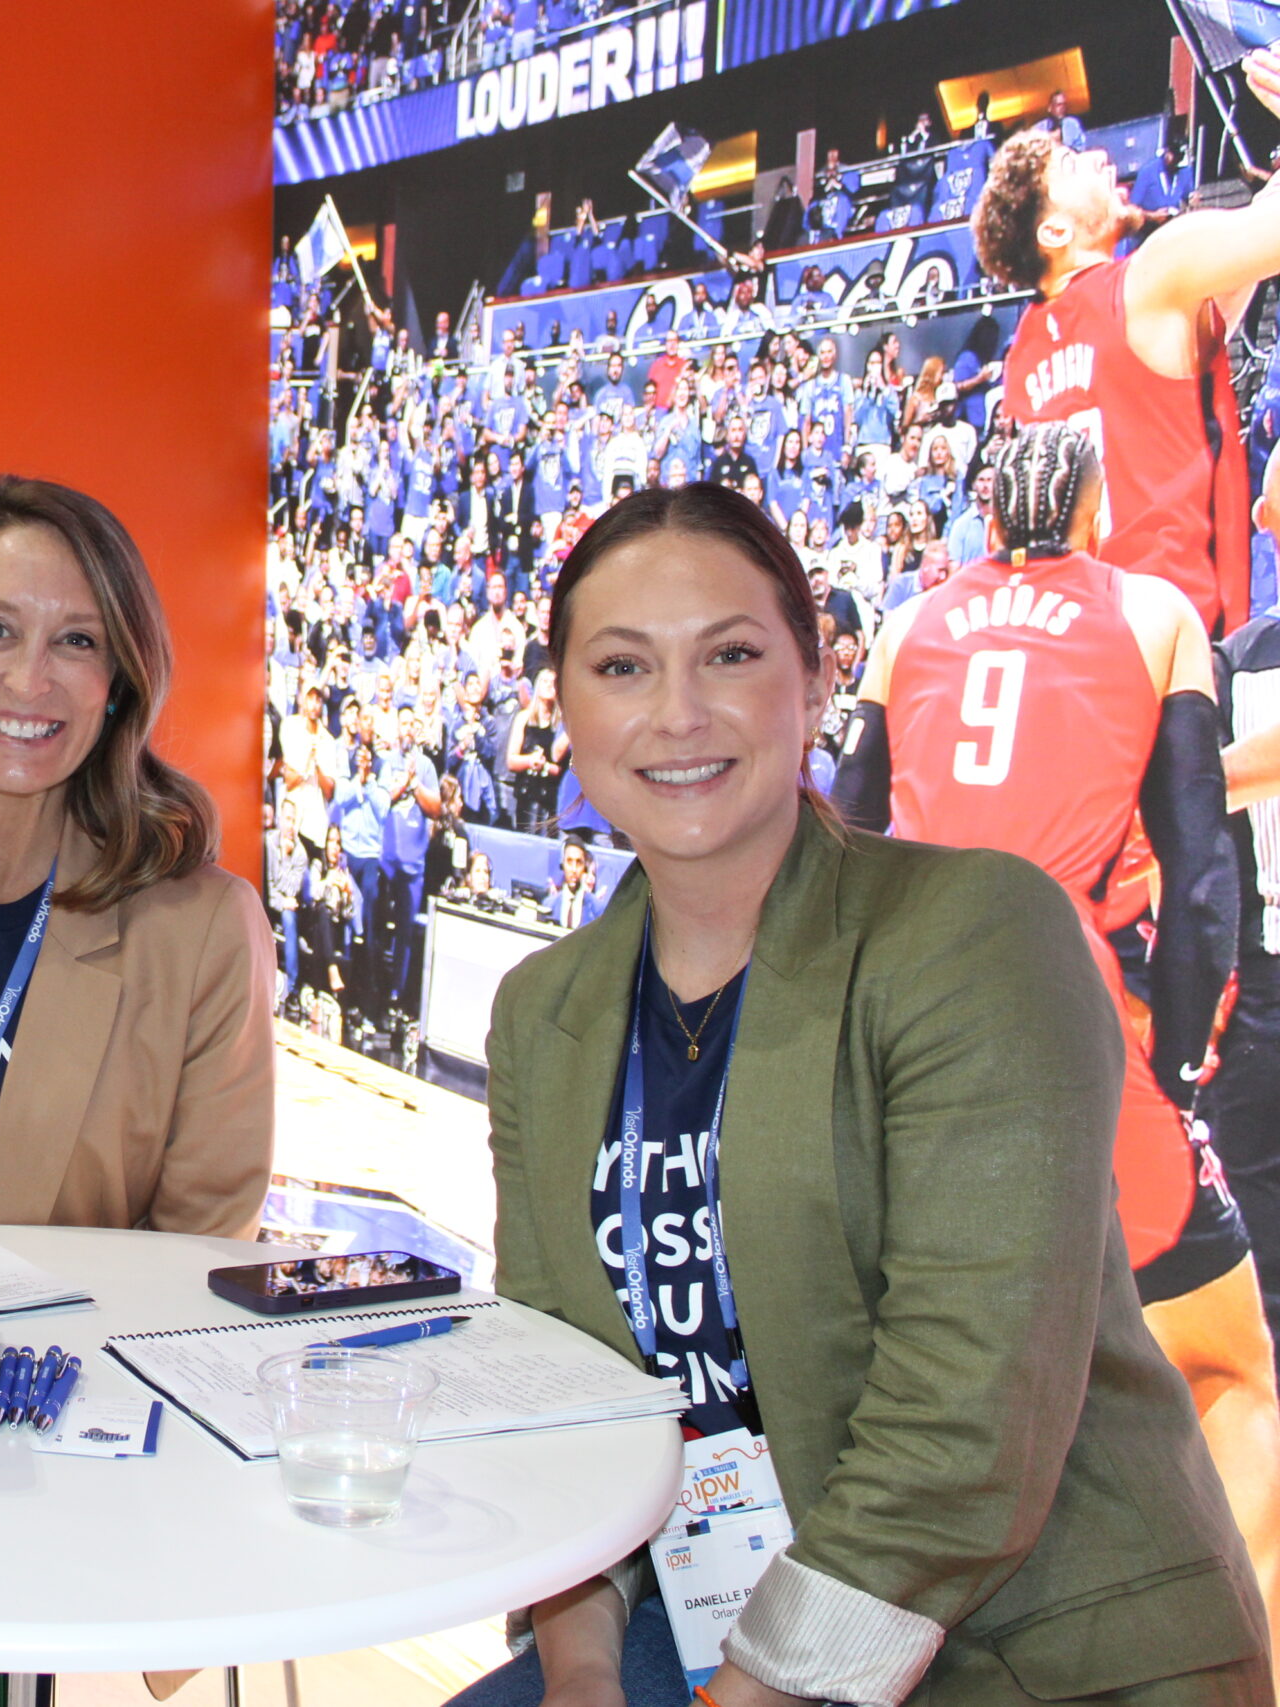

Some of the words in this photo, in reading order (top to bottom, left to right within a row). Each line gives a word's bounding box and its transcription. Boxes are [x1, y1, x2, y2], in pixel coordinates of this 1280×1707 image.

[455, 1, 707, 139] LOUDER!!!
[945, 584, 1082, 641] BROOKS
[953, 649, 1027, 786] 9
[693, 1471, 740, 1505] ipw
[666, 1552, 692, 1572] ipw
[684, 1590, 742, 1610] DANIELLE
[712, 1604, 744, 1620] Orland
